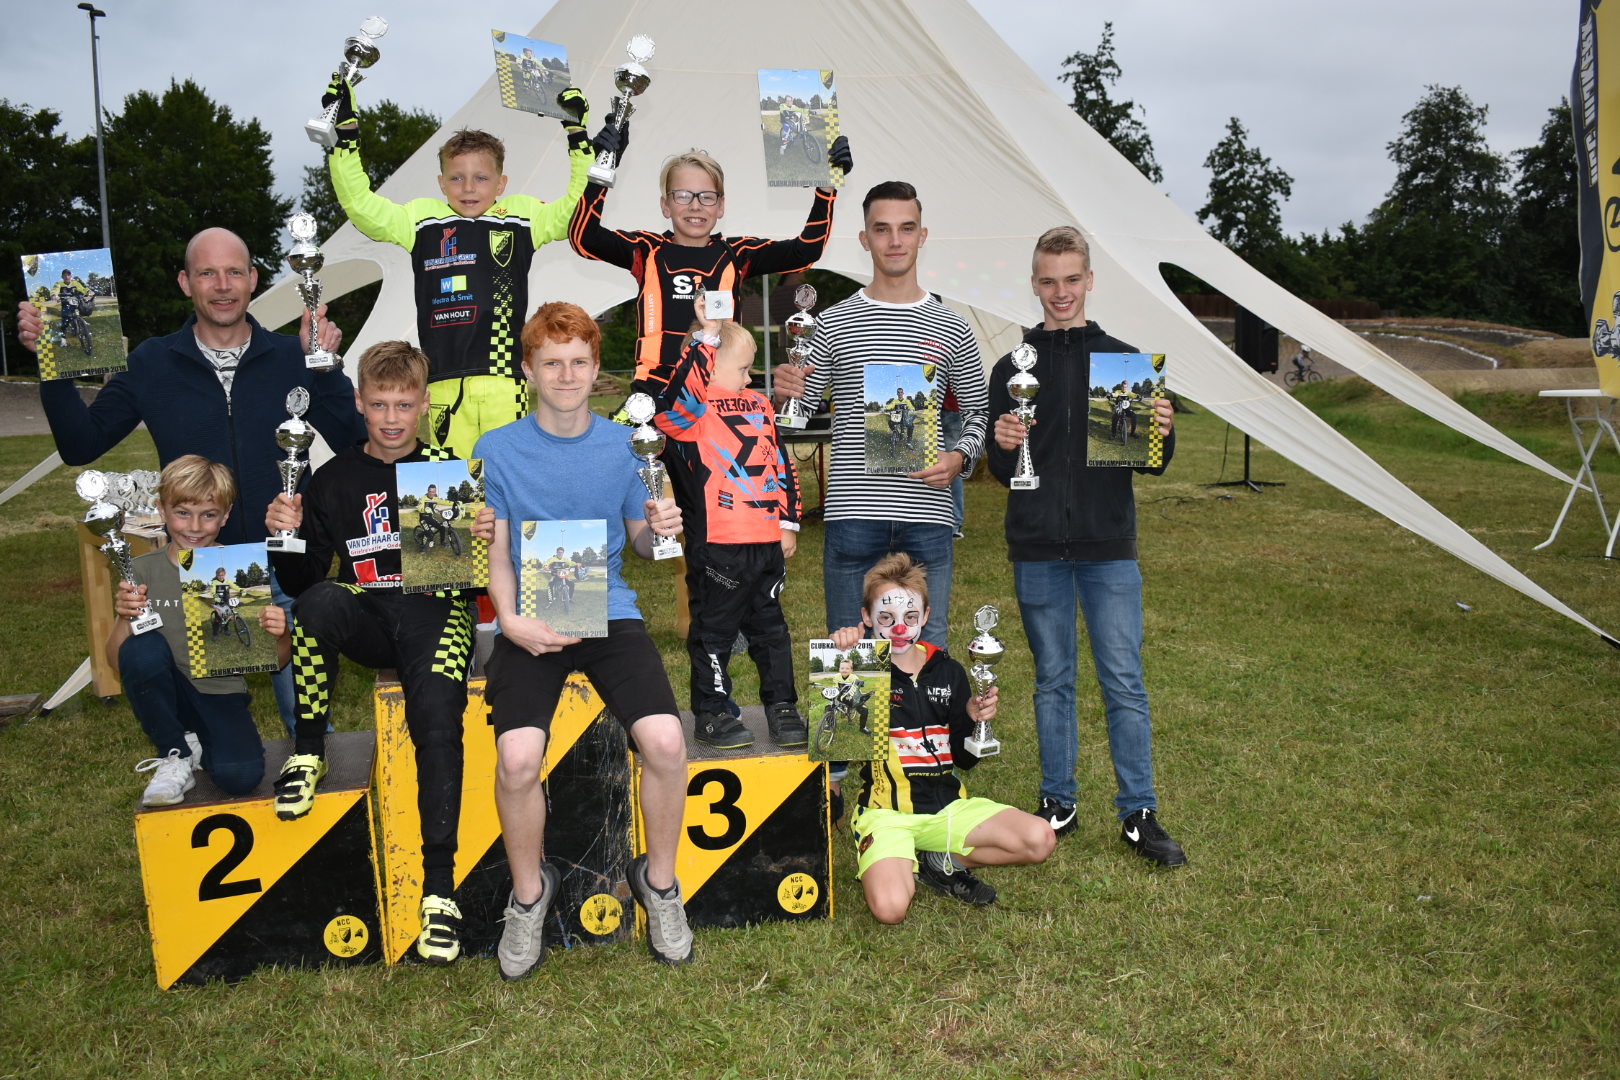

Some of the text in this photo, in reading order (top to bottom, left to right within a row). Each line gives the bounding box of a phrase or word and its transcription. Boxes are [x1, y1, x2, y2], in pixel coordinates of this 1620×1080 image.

[457, 293, 473, 301] Smit
[434, 312, 449, 321] VAN
[347, 540, 361, 550] VAN
[372, 534, 391, 545] HAAR
[405, 583, 455, 594] CLUBKAMPIOEN
[210, 663, 277, 676] CLUBKAMPIOEN 2019
[687, 768, 746, 850] 3
[191, 813, 263, 902] 2
[336, 918, 351, 927] NCC
